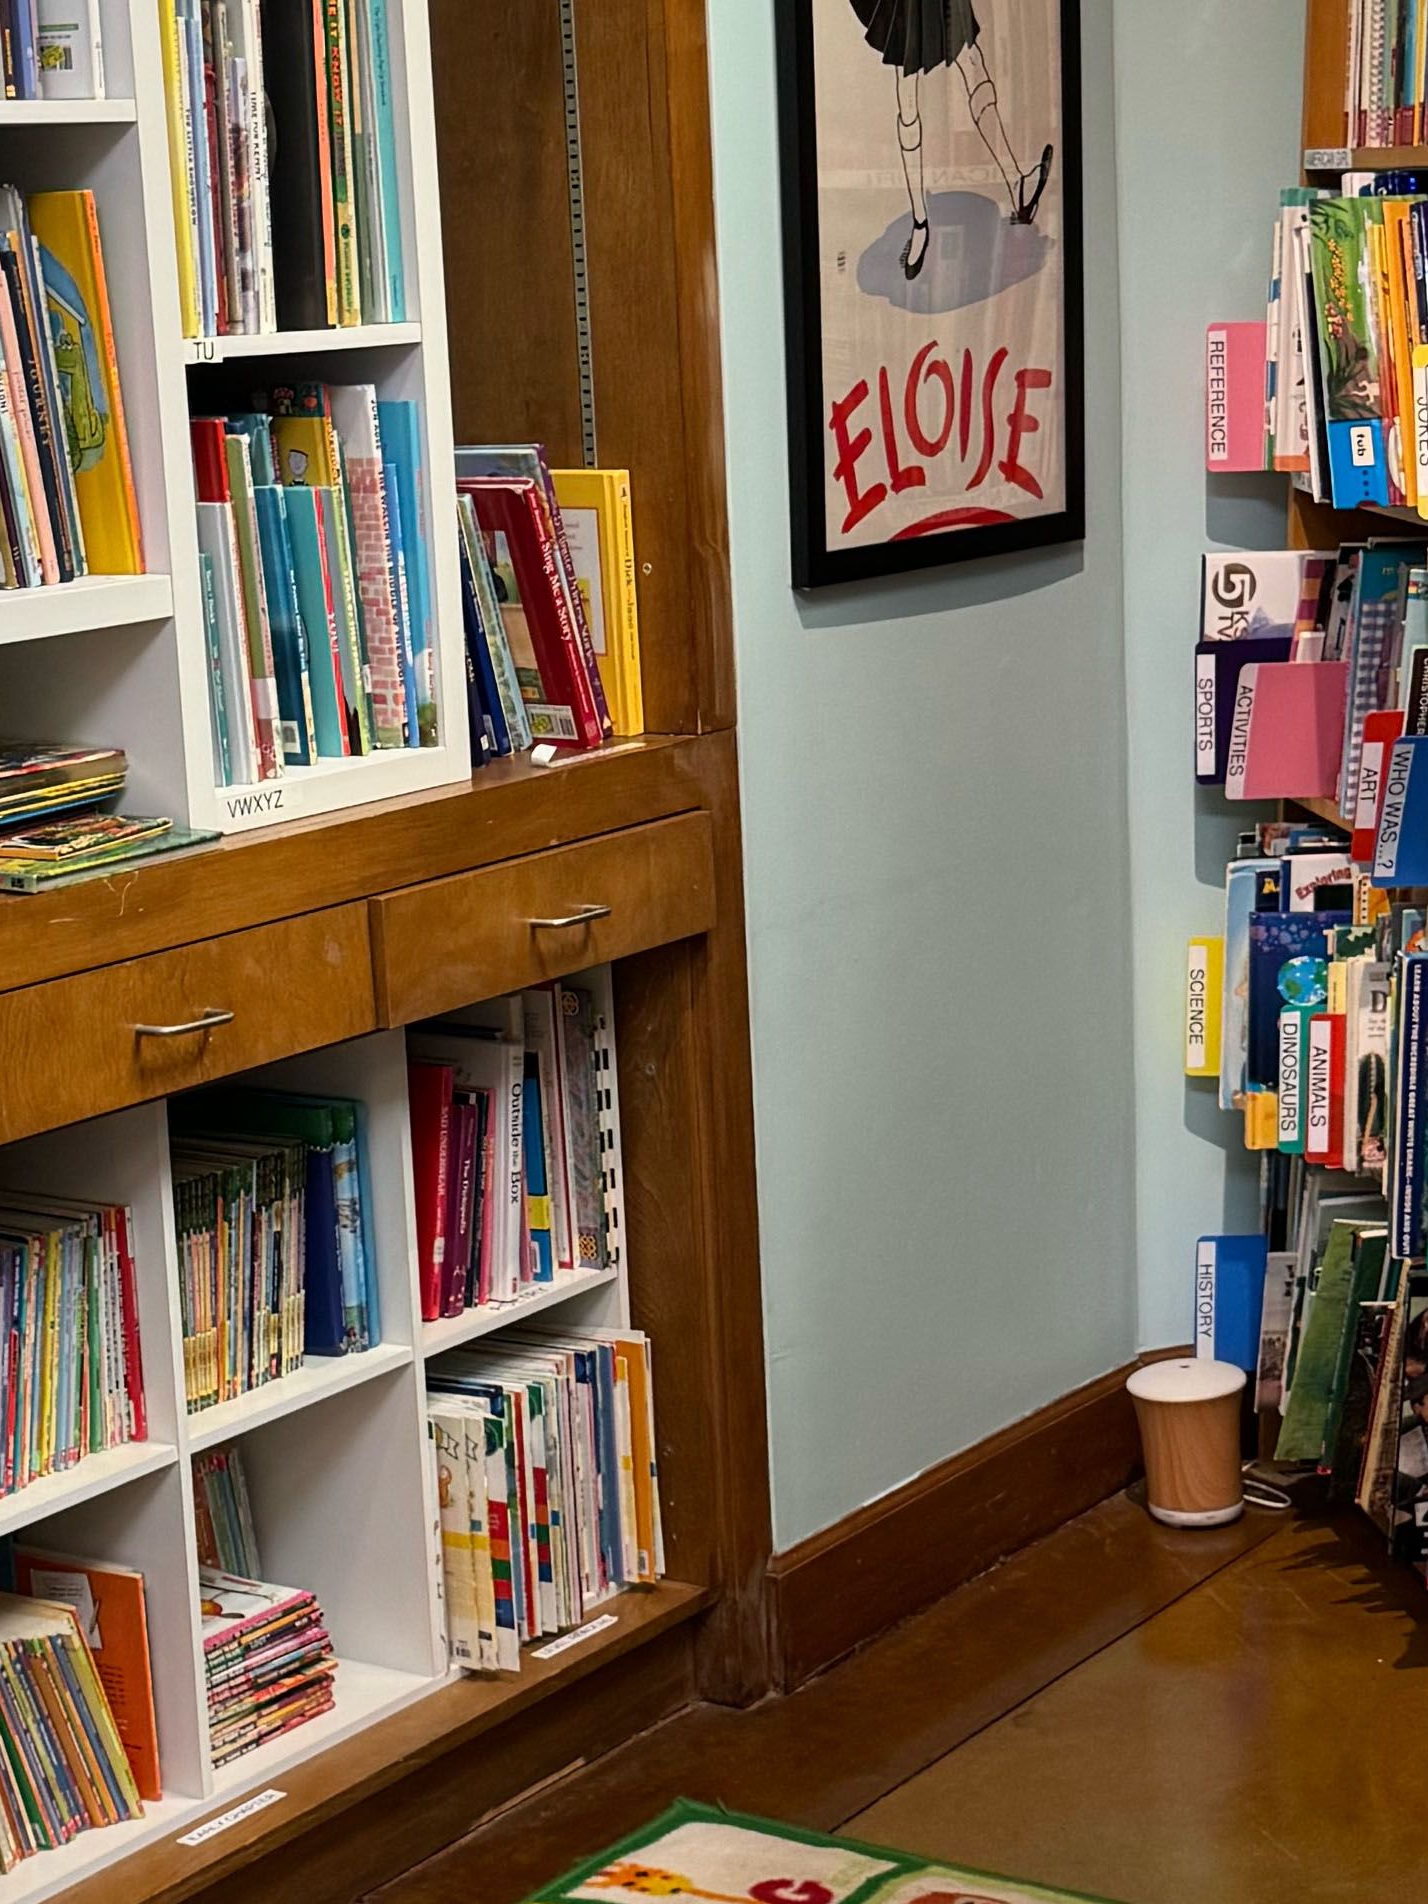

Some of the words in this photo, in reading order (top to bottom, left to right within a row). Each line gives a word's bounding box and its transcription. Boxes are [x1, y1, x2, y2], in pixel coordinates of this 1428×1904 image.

[193, 342, 215, 360] TU
[1208, 339, 1225, 455] REFERENCE
[829, 337, 1055, 536] ELOISE
[540, 540, 557, 576] Sing
[1198, 677, 1213, 752] SPORTS
[1229, 685, 1253, 777] ACTIVITIES
[227, 791, 284, 818] VWXYZ
[1361, 768, 1377, 804] ART
[1387, 750, 1410, 795] WHO
[1377, 800, 1400, 870] WAS...?
[1294, 866, 1353, 902] Exploring
[1188, 968, 1204, 1045] SCIENCE
[1281, 1022, 1299, 1133] DINOSAURS
[1310, 1044, 1327, 1130] ANIMALS
[511, 1082, 521, 1146] Outside
[510, 1172, 519, 1204] Box
[1199, 1263, 1213, 1341] HISTORY
